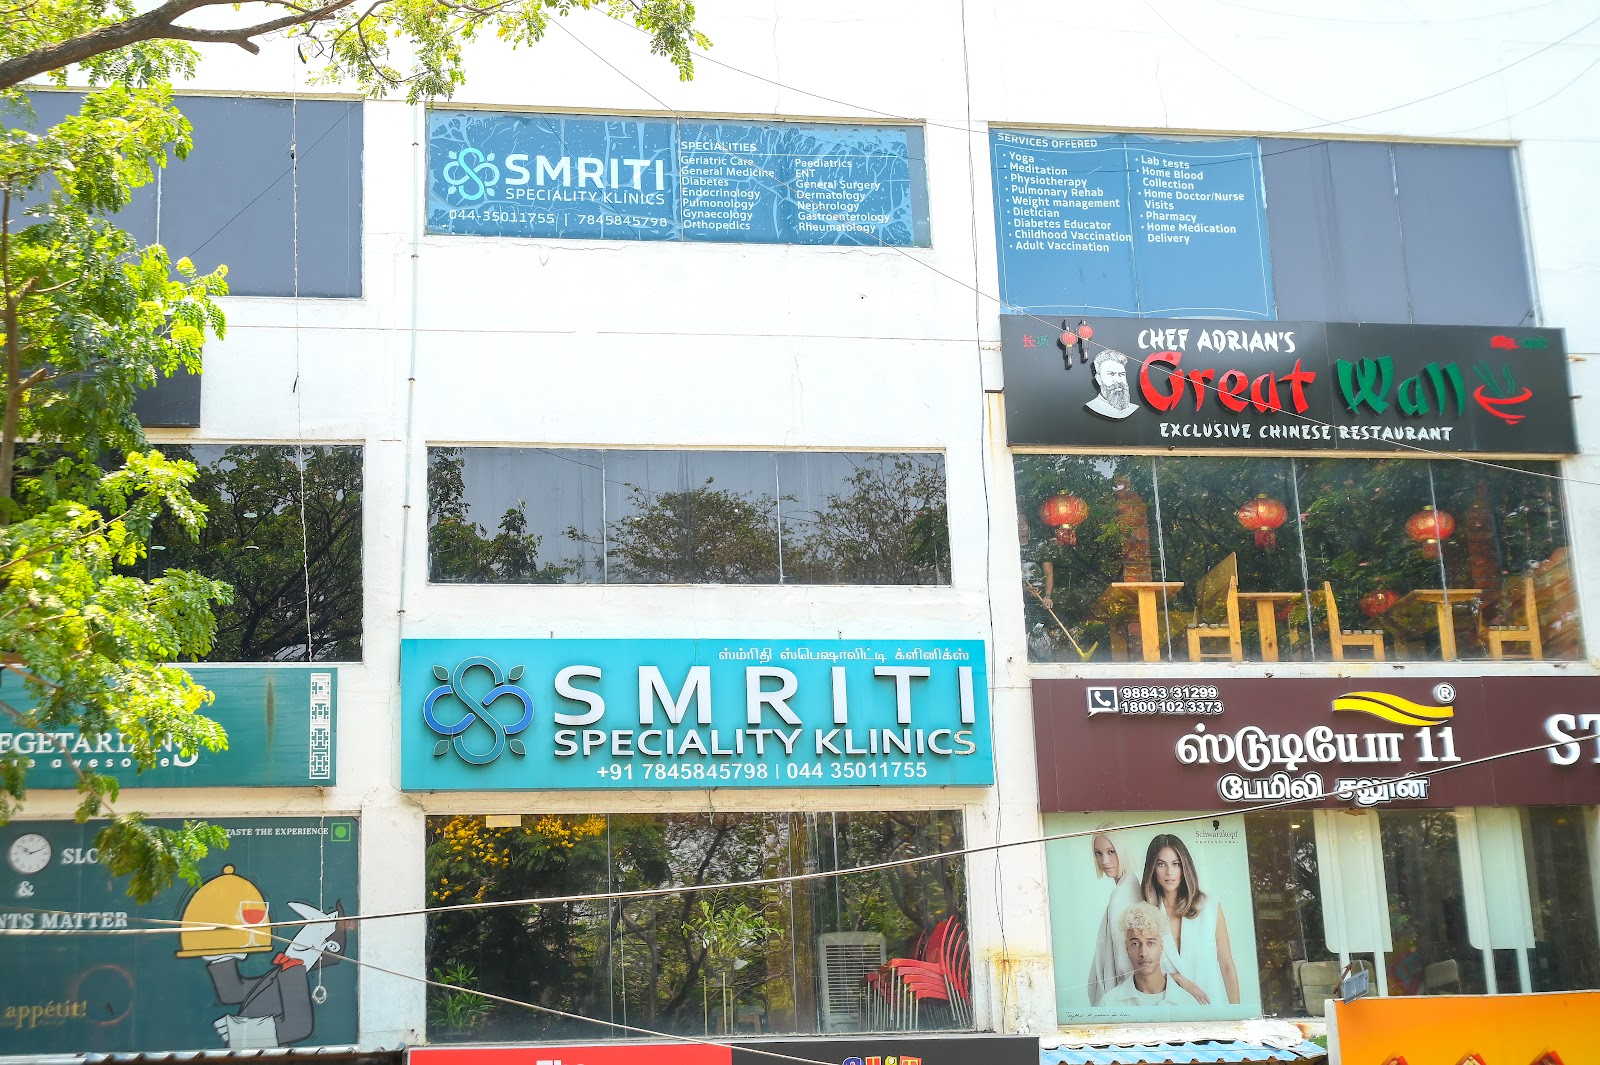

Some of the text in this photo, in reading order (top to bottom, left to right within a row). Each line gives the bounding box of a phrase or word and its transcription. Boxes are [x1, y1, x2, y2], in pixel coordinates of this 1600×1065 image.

[681, 141, 757, 152] SPECIALITIES
[998, 133, 1098, 149] SERVICES OFFERED
[681, 156, 754, 166] Geriatric Care
[795, 159, 852, 169] Paediatrics
[1009, 151, 1035, 164] Yoga
[1141, 155, 1190, 170] Lab tests
[505, 153, 665, 191] SMRITI
[681, 166, 775, 177] General Medicine
[796, 169, 816, 178] ENT
[1010, 163, 1068, 176] Meditation
[1142, 167, 1204, 180] Home Blood
[682, 177, 729, 187] Diabetes
[796, 180, 881, 192] General Surgery
[1011, 174, 1087, 188] Physiotherapy
[1143, 178, 1194, 190] Collection
[505, 188, 665, 205] SPECIALITY KLINICS
[682, 188, 760, 200] Endocrinology
[797, 190, 865, 202] Dermatology
[1011, 185, 1104, 199] Pulmonary Rehab
[1144, 189, 1244, 201] Home Doctor/Nurse
[683, 198, 754, 210] Pulmonology
[797, 201, 860, 213] Nephrology
[1012, 196, 1121, 211] Weight management
[1145, 200, 1174, 210] Visits
[449, 209, 668, 227] 044-35011755 7845845798
[683, 209, 753, 221] Gynaecology
[798, 211, 890, 224] Gastroenterology
[1013, 207, 1060, 218] Dietician
[1146, 211, 1197, 224] Pharmacy
[683, 220, 750, 231] Orthopedics
[799, 222, 876, 234] Rheumatology
[1014, 218, 1111, 231] Diabetes Educator
[1147, 223, 1236, 234] Home Medication
[1015, 230, 1132, 242] Childhood Vaccination
[1148, 233, 1190, 245] Delivery
[1016, 241, 1110, 252] Adult Vaccination
[1138, 328, 1296, 353] CHEF ADRIAN'S
[1139, 351, 1466, 416] Great Wall
[1160, 423, 1453, 442] EXCLUSIVE CHINESE RESTAURANT
[554, 665, 976, 727] SMRITI
[1121, 686, 1218, 699] 98843 31299
[1121, 700, 1224, 713] 1800 102 3373
[554, 728, 977, 757] SPECIALITY KLINICS
[1176, 722, 1461, 771] ஸ்டுடியோ 11
[51, 758, 169, 768] awesoe
[597, 761, 927, 780] +91 7845845798 044 35011755
[1219, 772, 1324, 801] பேமிலி
[226, 827, 328, 836] TASTE THE EXPERIENCE
[1195, 829, 1239, 839] Schwarzkopf
[17, 880, 34, 897] &
[40, 911, 128, 929] MATTER
[6, 1000, 87, 1028] appétit!
